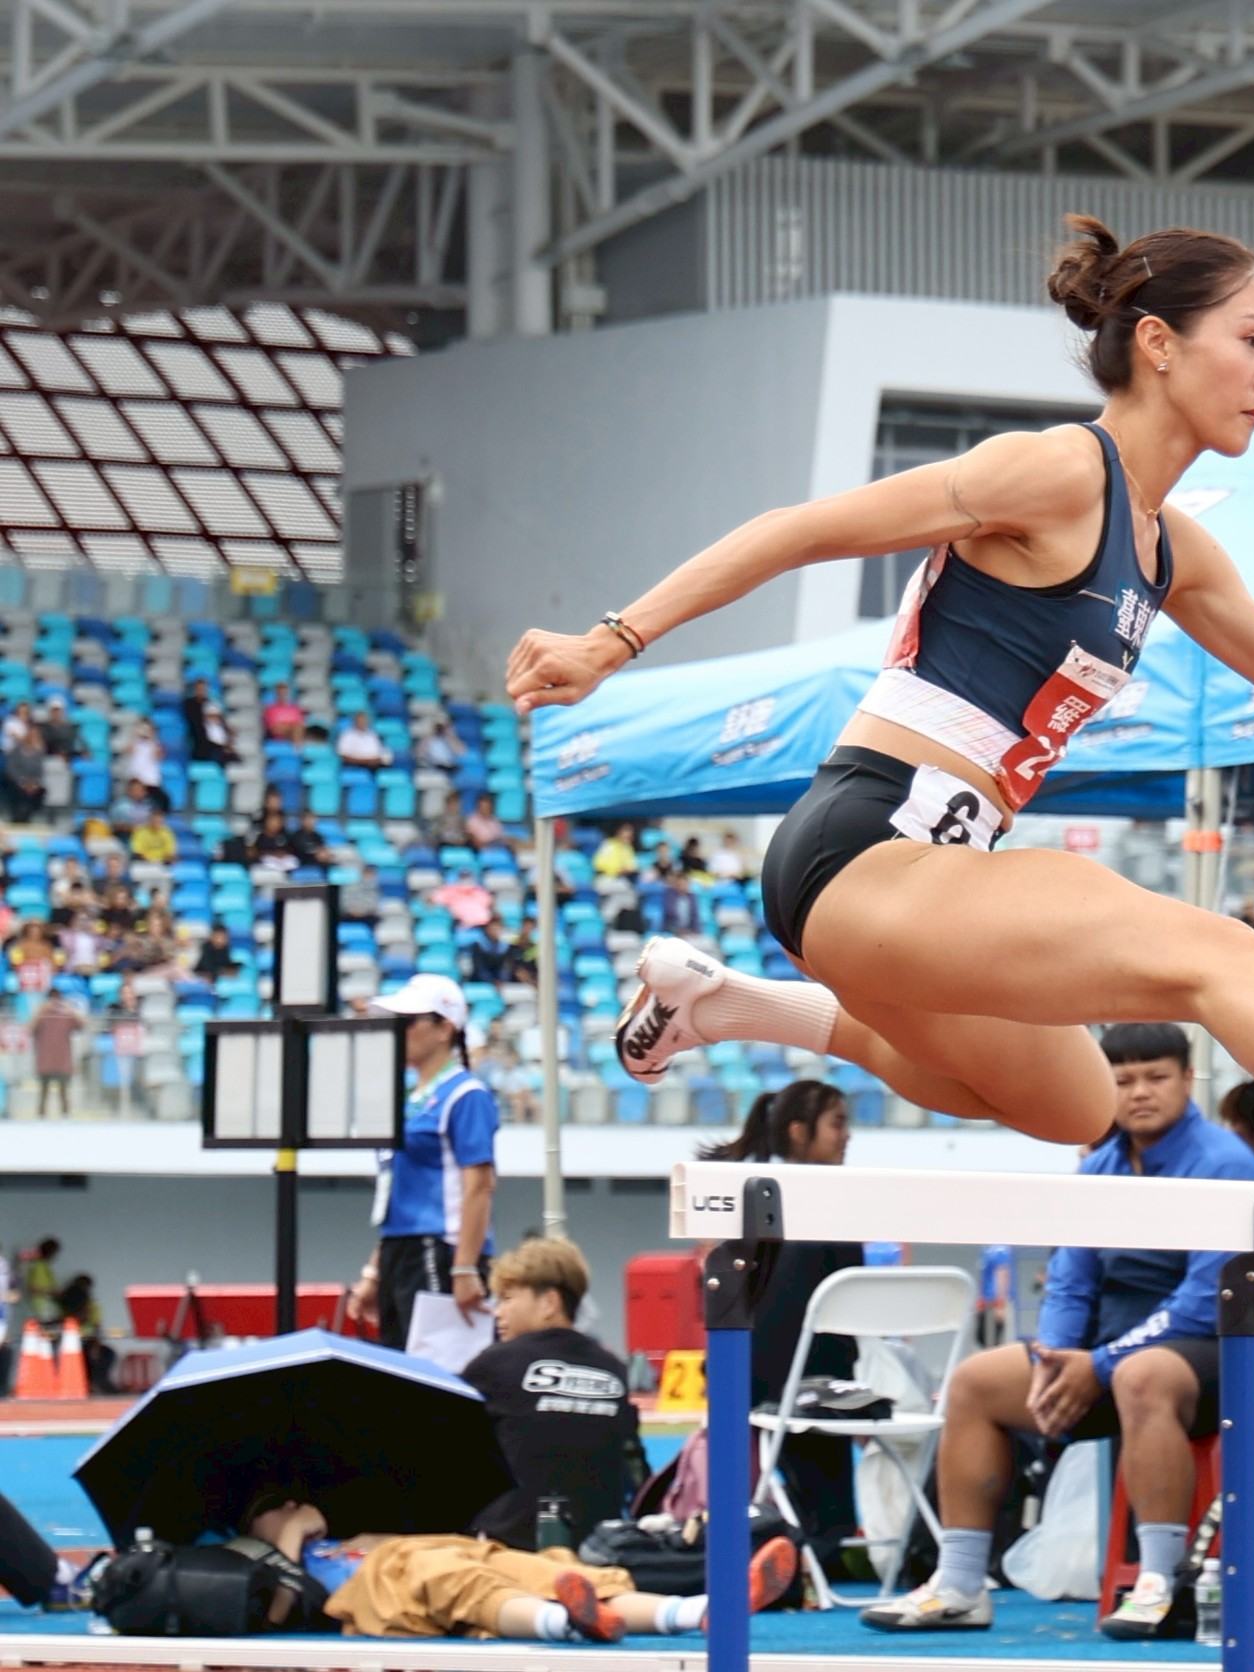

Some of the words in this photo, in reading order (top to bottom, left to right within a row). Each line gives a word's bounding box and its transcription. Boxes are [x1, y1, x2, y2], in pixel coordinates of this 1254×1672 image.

[1114, 587, 1157, 648] 臺東
[1047, 694, 1093, 733] 羅
[931, 791, 980, 844] 6
[692, 1195, 735, 1212] UCS
